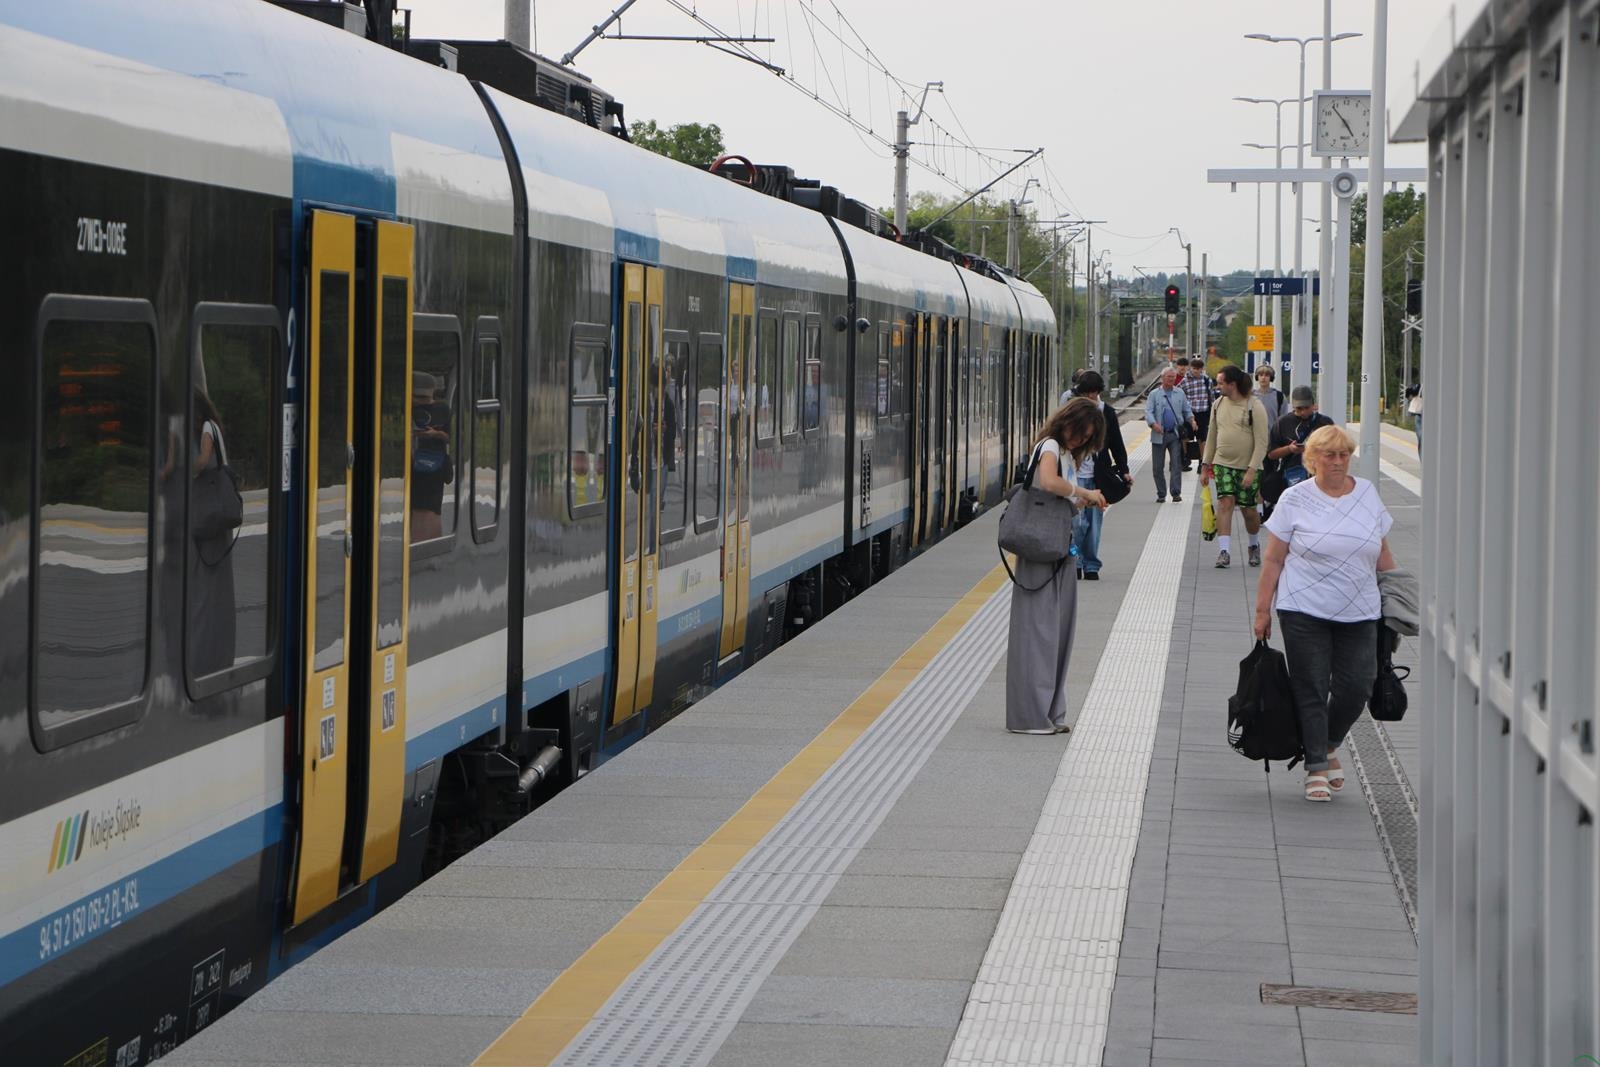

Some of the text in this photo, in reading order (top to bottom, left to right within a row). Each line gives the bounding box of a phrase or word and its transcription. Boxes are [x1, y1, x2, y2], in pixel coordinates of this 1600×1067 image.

[1260, 283, 1265, 293] 1
[286, 307, 296, 388] 2
[90, 810, 114, 850] Koleje
[40, 922, 51, 959] 94
[53, 917, 62, 952] 51
[64, 913, 71, 946] 2
